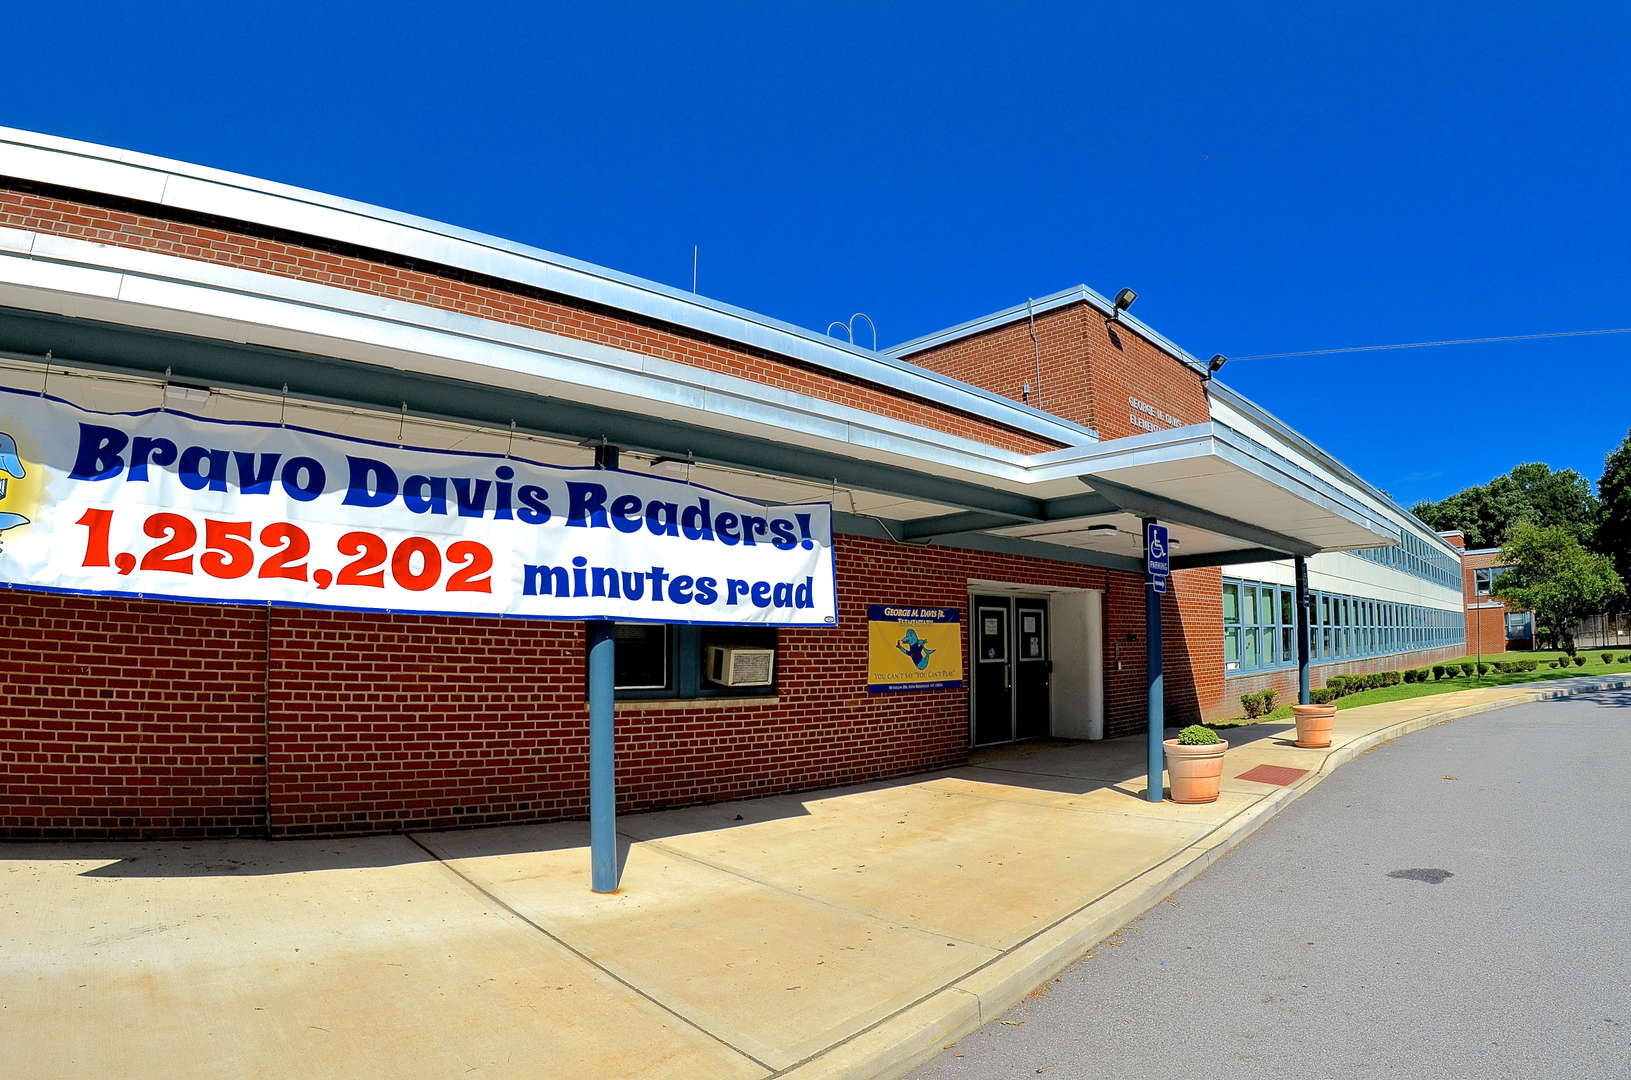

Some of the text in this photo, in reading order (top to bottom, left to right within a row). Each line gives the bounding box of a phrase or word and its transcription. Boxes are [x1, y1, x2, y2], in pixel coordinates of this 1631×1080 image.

[1128, 396, 1156, 417] GEORGE
[67, 422, 814, 551] Bravo Davis Readers!
[75, 507, 814, 609] 1,252,202 minutes read
[884, 607, 911, 617] GEORGE
[920, 609, 937, 618] DAVIS
